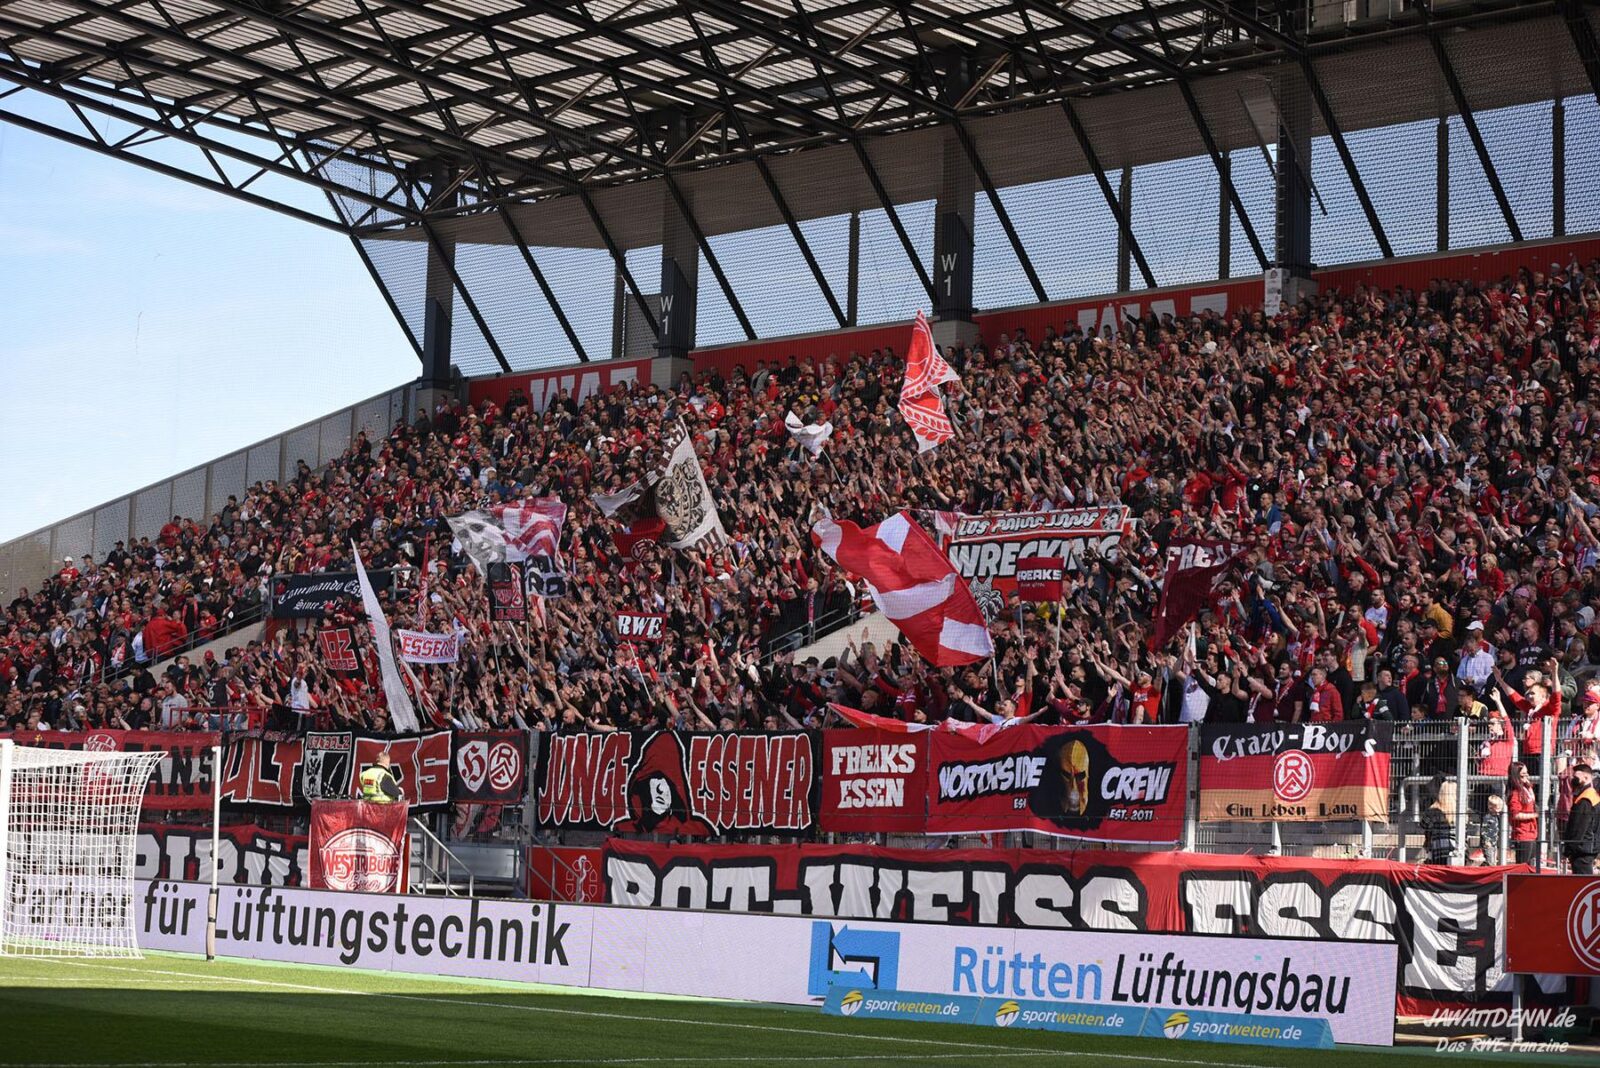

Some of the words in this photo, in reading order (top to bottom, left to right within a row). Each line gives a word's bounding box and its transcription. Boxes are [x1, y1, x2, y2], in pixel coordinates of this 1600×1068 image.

[941, 252, 957, 272] W
[944, 275, 952, 296] 1
[660, 294, 674, 313] W
[662, 315, 669, 335] 1
[958, 520, 990, 536] LOS
[1017, 569, 1062, 581] FREAKS
[618, 615, 663, 636] RWE
[831, 744, 916, 775] FREAKS
[538, 731, 632, 826] JUNGE
[689, 732, 813, 830] ESSENER
[938, 756, 1047, 799] NORTHSIDE
[1101, 767, 1171, 801] CREW
[837, 778, 905, 809] ESSEN
[1109, 808, 1128, 820] EST.
[1130, 808, 1153, 821] 2011
[1226, 803, 1253, 817] Ein
[1262, 802, 1306, 817] Leben
[1319, 802, 1358, 816] Lang
[144, 880, 196, 936] für
[952, 946, 1102, 1001] Rütten
[1111, 952, 1351, 1014] Lüftungsbau
[864, 998, 960, 1017] sportwetten.de
[1021, 1009, 1124, 1028] sportwetten.de
[1192, 1021, 1302, 1040] sportwetten.de
